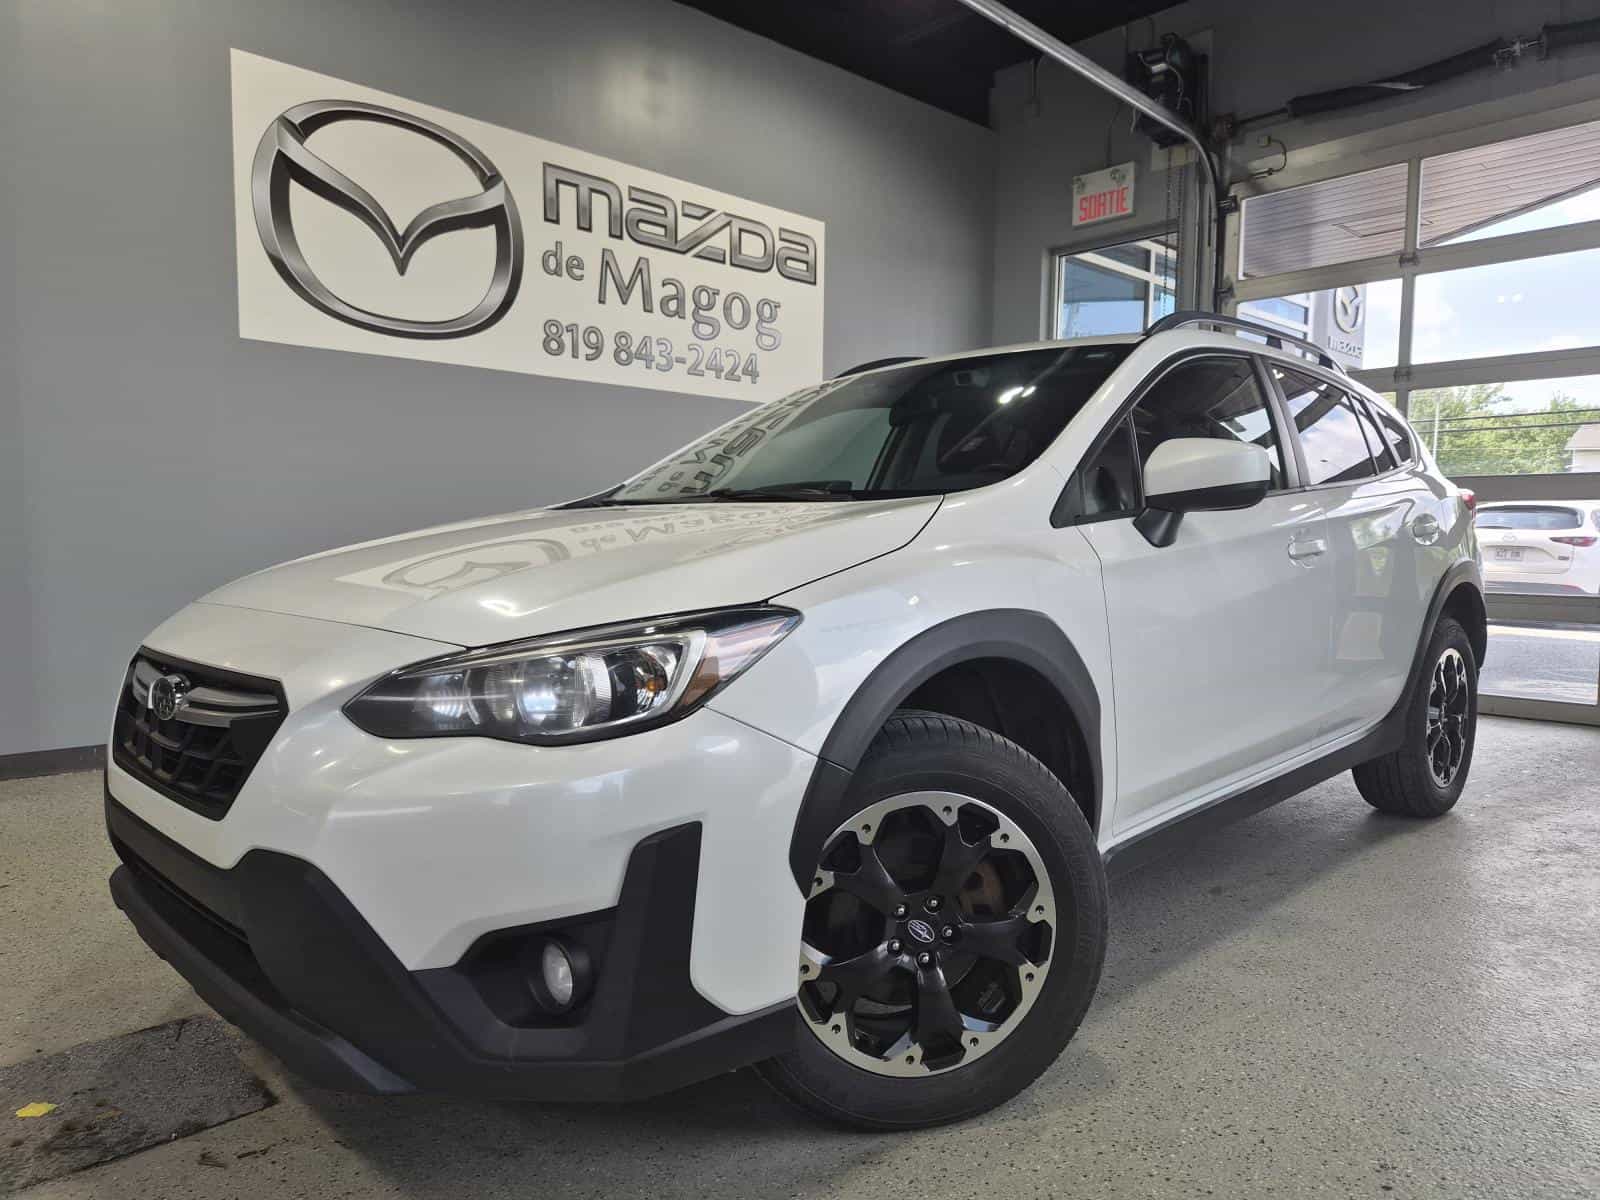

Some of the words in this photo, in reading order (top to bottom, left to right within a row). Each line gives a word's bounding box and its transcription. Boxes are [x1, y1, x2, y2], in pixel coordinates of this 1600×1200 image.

[542, 162, 818, 286] mazda
[1079, 185, 1129, 222] SORTIE
[541, 241, 585, 281] de
[598, 247, 782, 352] Magog
[542, 319, 604, 361] 819
[613, 331, 760, 384] 843-2424
